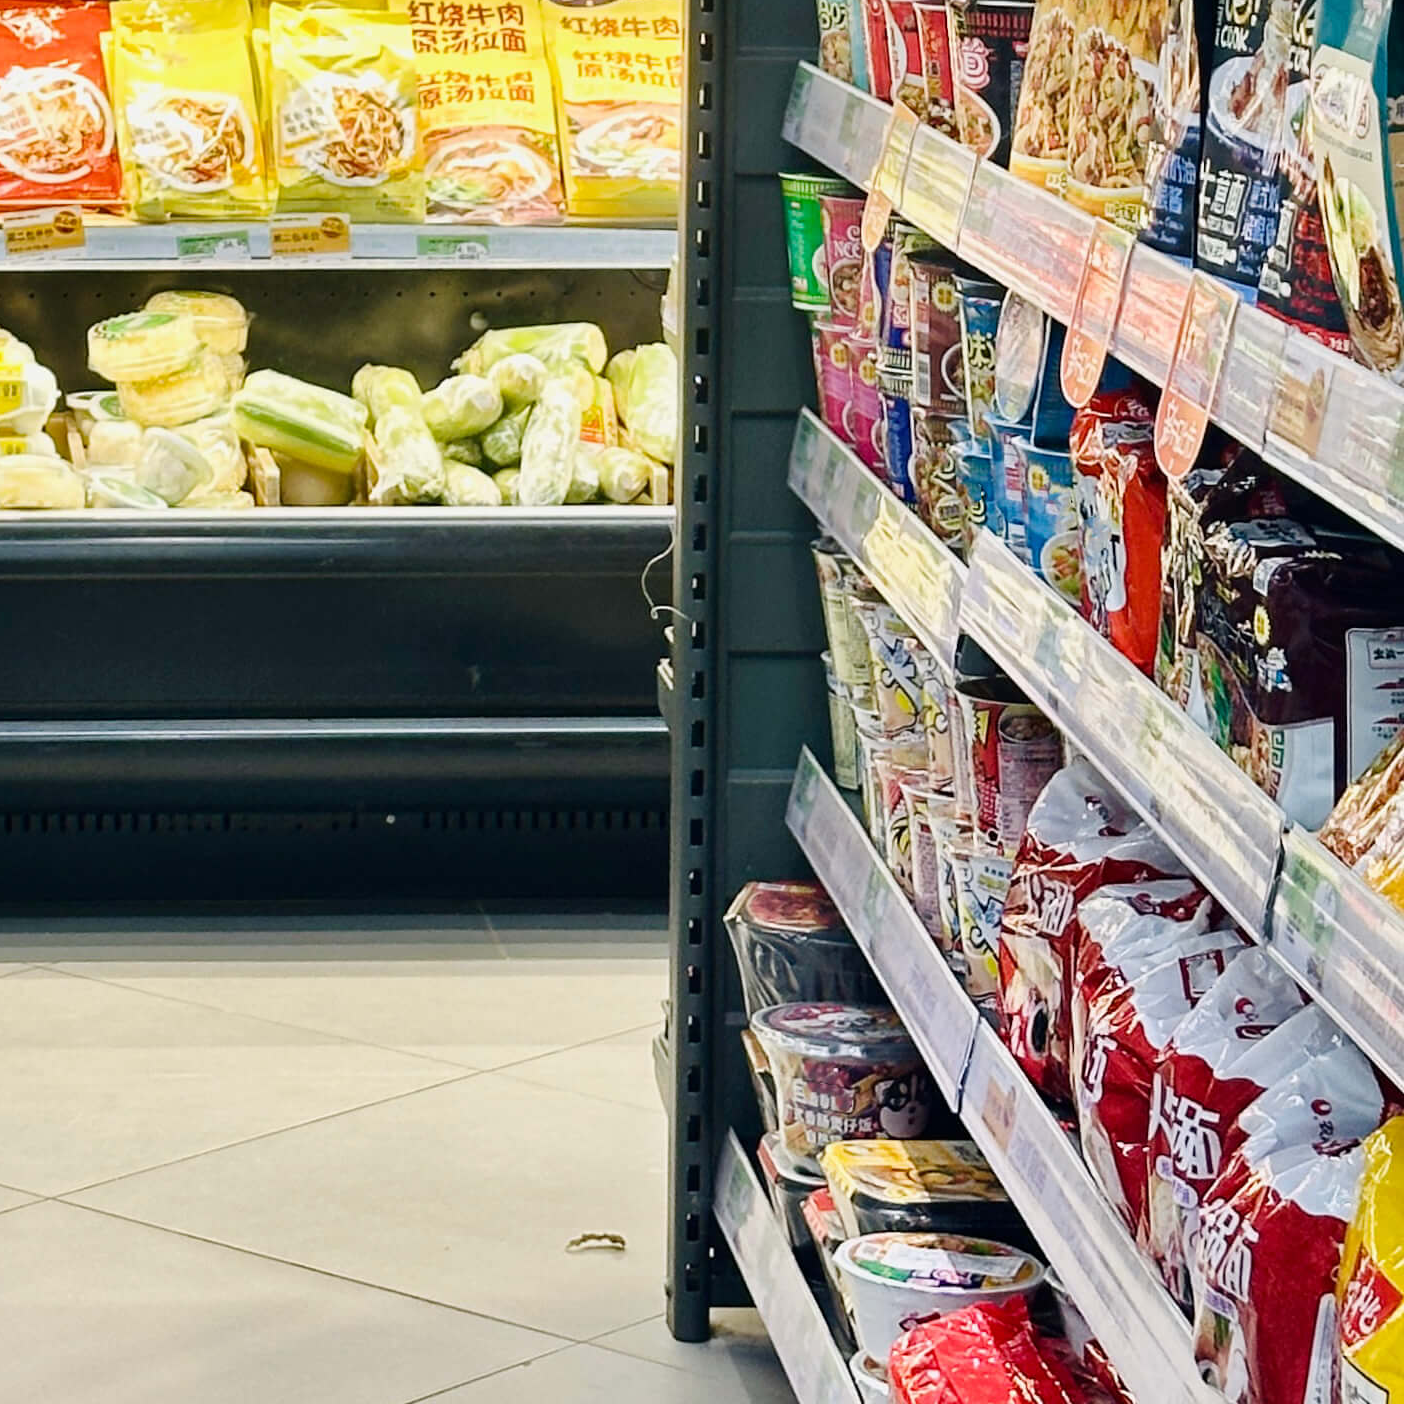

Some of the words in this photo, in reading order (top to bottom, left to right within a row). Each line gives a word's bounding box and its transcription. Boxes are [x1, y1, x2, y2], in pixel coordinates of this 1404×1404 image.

[407, 0, 525, 27] 红烧牛肉
[559, 15, 681, 38] 红烧牛肉
[412, 28, 527, 54] 原汤拉面
[417, 69, 534, 88] 红烧牛肉
[417, 84, 535, 110] 原汤拉面
